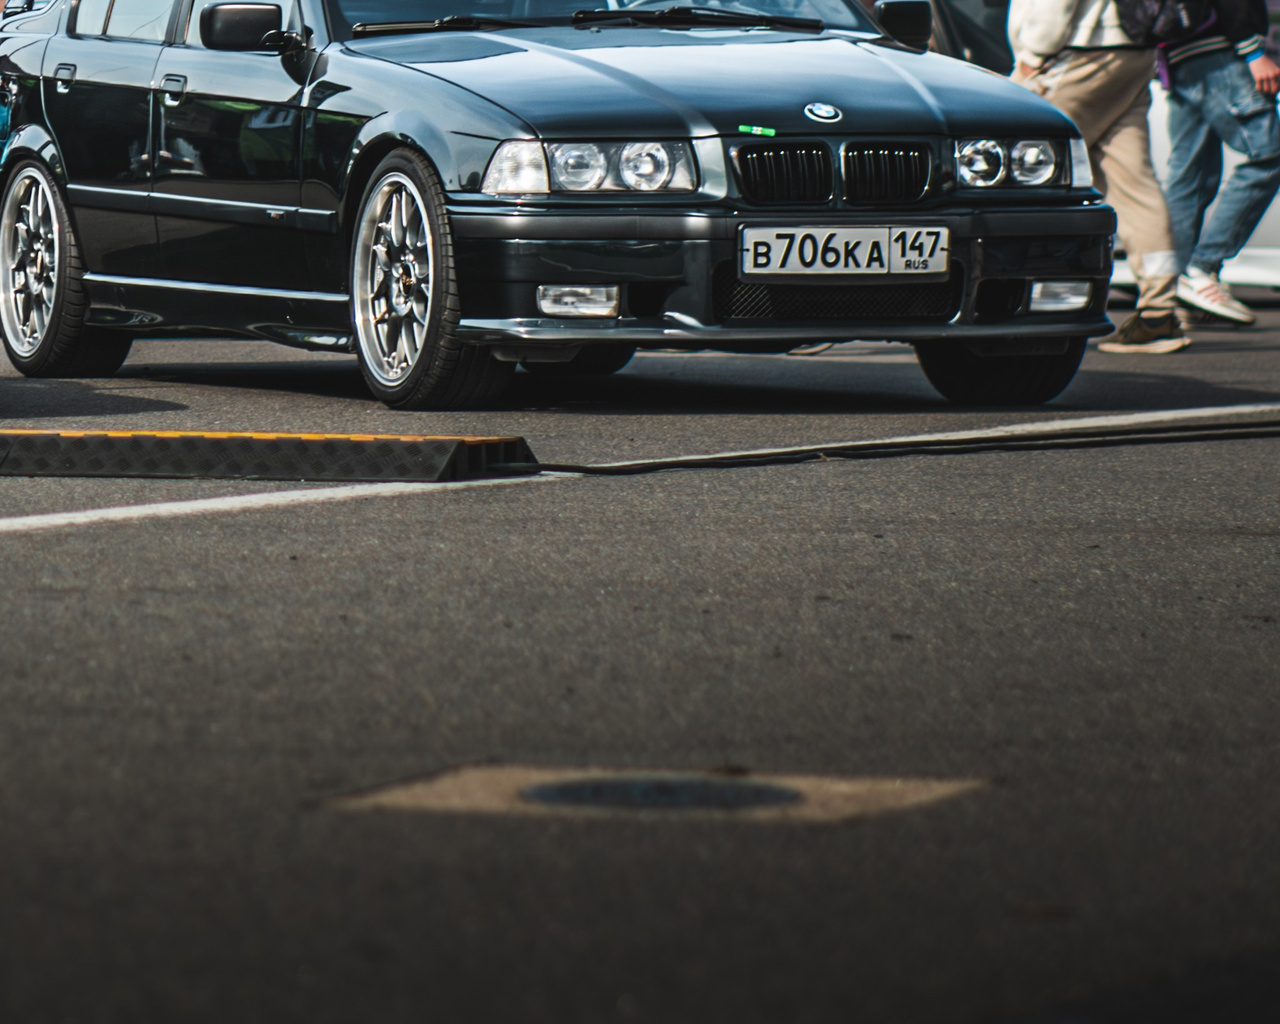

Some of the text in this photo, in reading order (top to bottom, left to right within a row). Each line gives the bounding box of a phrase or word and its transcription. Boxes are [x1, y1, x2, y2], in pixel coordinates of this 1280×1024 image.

[752, 230, 941, 269] В706КА 147
[904, 259, 929, 270] RUS
